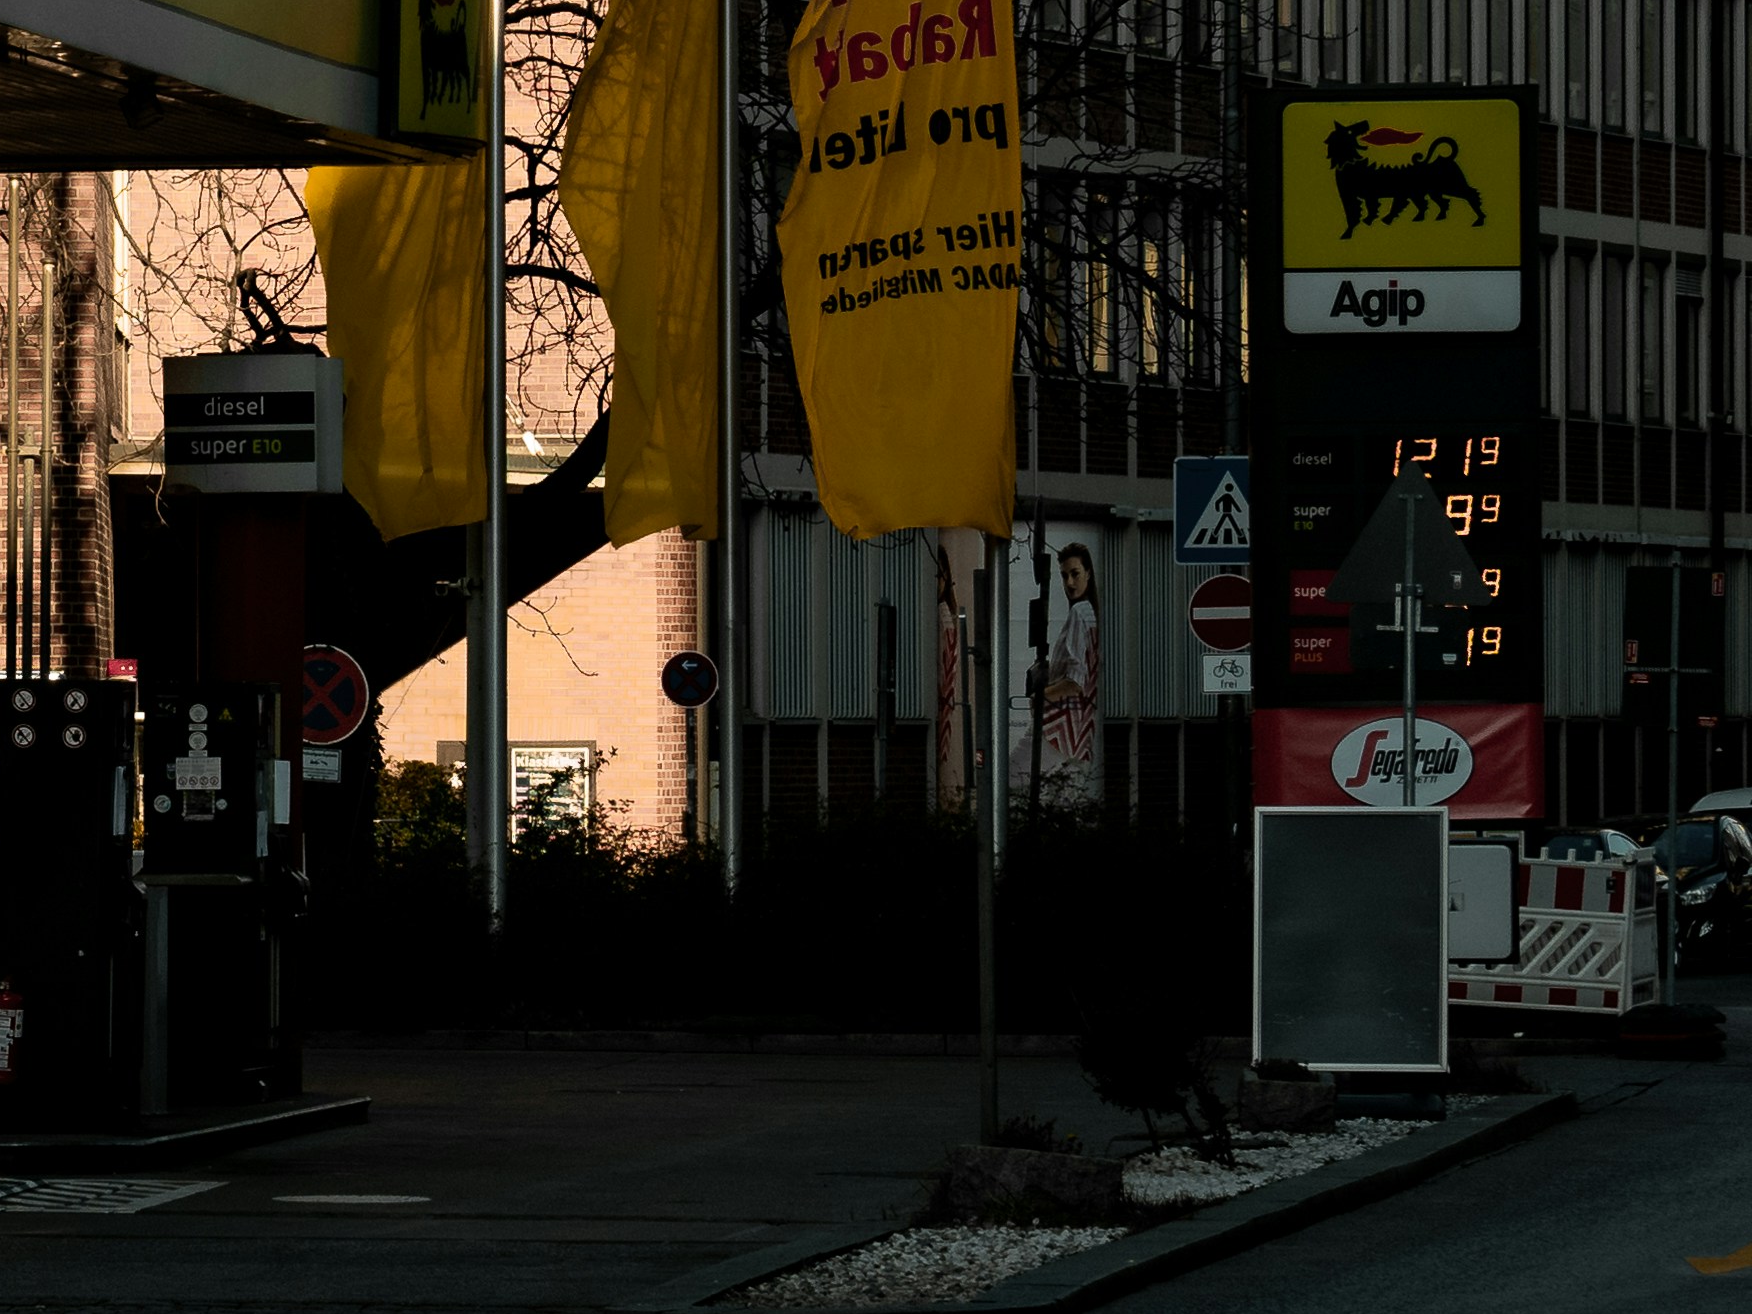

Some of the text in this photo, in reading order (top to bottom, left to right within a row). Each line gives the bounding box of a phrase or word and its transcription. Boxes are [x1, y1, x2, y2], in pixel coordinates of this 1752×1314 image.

[1329, 279, 1426, 328] Agip
[204, 395, 265, 417] diesel
[191, 439, 283, 461] super E10
[1292, 451, 1333, 466] diesel
[1293, 502, 1332, 519] super
[1294, 520, 1314, 531] E10
[1294, 583, 1326, 598] supe
[1294, 634, 1333, 653] super
[1294, 652, 1324, 663] PLUS
[1220, 679, 1238, 689] frei
[1344, 729, 1460, 788] Segaredo
